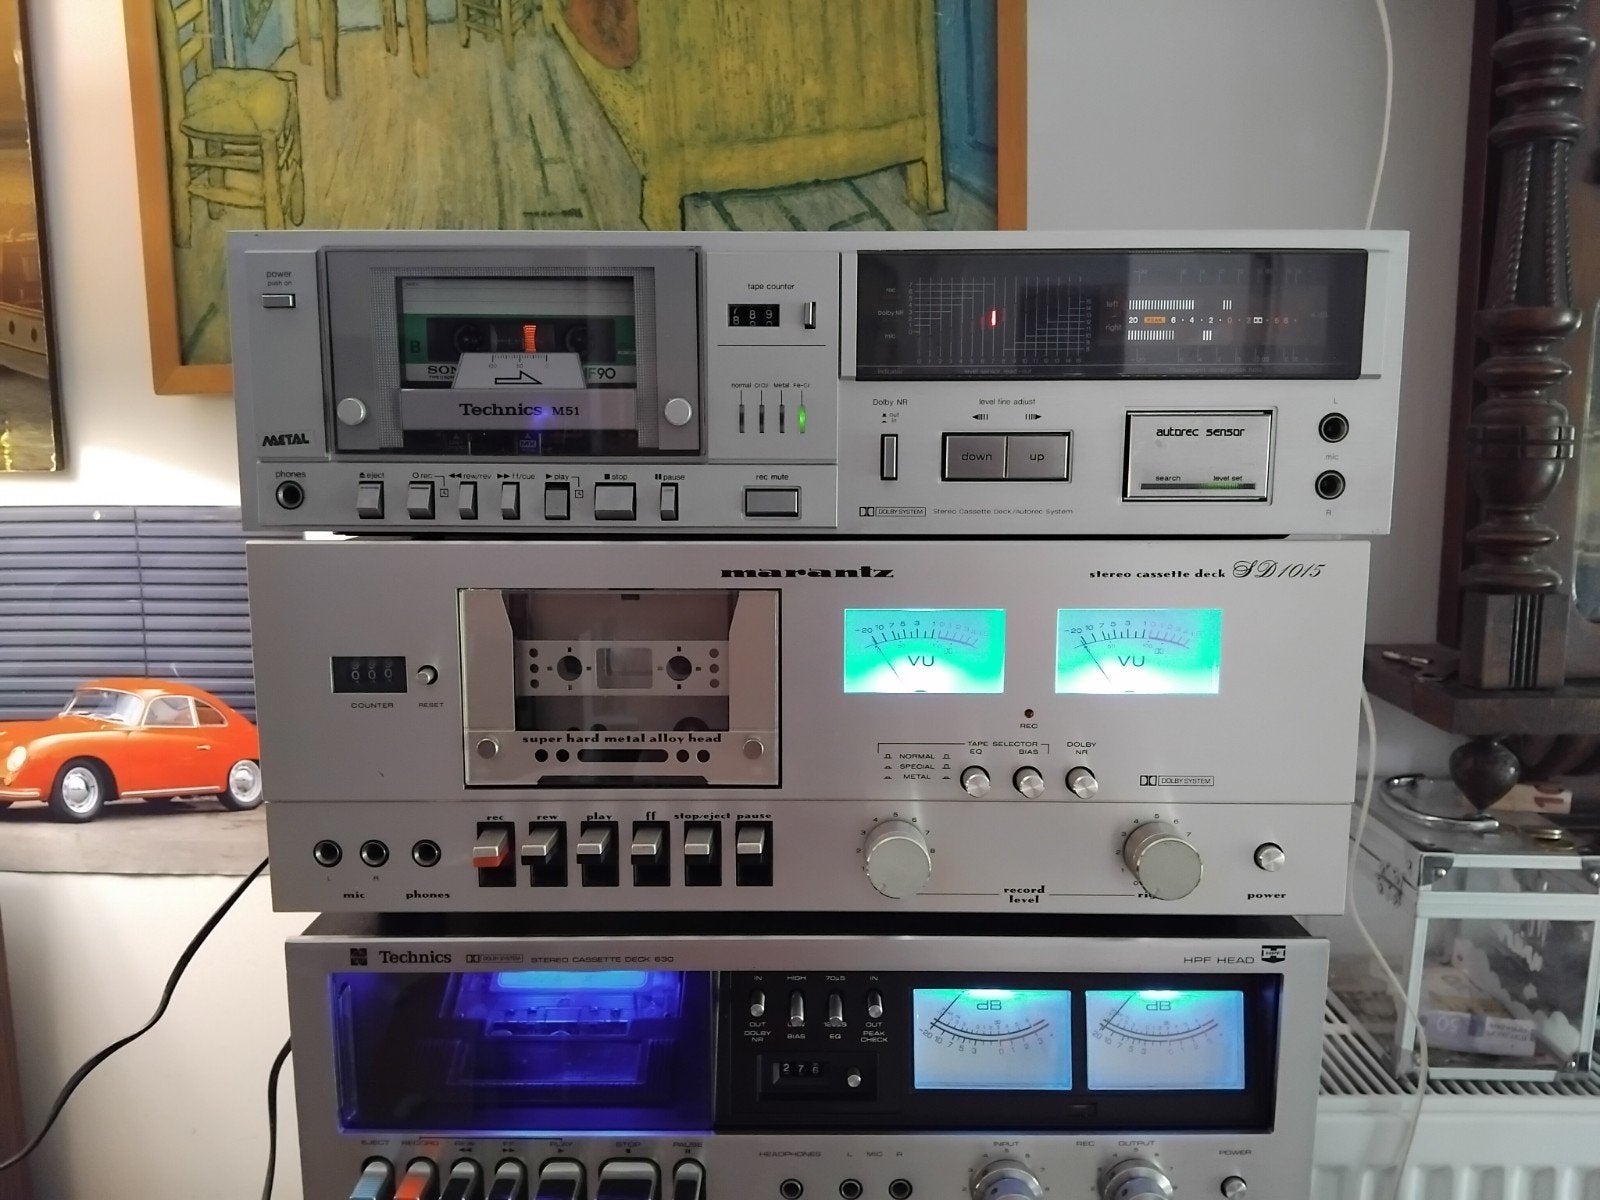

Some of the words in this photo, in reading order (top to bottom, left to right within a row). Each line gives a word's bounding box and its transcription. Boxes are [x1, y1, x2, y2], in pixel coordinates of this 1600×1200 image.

[266, 270, 292, 279] power
[1106, 300, 1119, 308] left
[1128, 316, 1139, 324] 20
[1171, 316, 1176, 324] 6
[1189, 316, 1195, 324] 4
[1208, 316, 1214, 324] 2
[1105, 324, 1122, 333] right
[410, 340, 420, 354] B
[427, 366, 457, 375] SON
[872, 398, 894, 407] Dolby
[896, 398, 908, 406] NR
[979, 398, 996, 406] level
[997, 398, 1011, 406] fine
[1013, 398, 1036, 406] adjust
[459, 403, 543, 416] Technics
[552, 406, 580, 416] M51
[1156, 427, 1199, 437] autorec
[1205, 427, 1245, 437] sensor
[262, 433, 310, 447] METAL
[961, 452, 993, 462] down
[1029, 453, 1044, 463] up
[1325, 453, 1339, 461] mic
[275, 470, 306, 479] phones
[366, 472, 385, 480] eject
[463, 472, 492, 480] rew/rev
[512, 472, 535, 480] ff/cue
[554, 473, 569, 481] play
[612, 473, 628, 481] stop
[1045, 508, 1073, 516] System
[720, 565, 894, 578] marantz
[1089, 569, 1132, 578] stereo
[1136, 569, 1190, 578] cassette
[1194, 569, 1226, 578] deck
[907, 655, 935, 667] VU
[1117, 655, 1145, 667] VU
[522, 735, 562, 745] super
[566, 733, 600, 743] hard
[604, 733, 645, 743] metal
[649, 733, 684, 745] alloy
[688, 733, 722, 743] head
[586, 812, 612, 821] play
[645, 811, 657, 821] ff
[736, 813, 772, 821] pause
[1003, 885, 1046, 894] record
[343, 891, 366, 899] mic
[405, 890, 450, 900] phones
[1009, 895, 1040, 904] level
[1247, 892, 1287, 900] power
[378, 950, 452, 964] Technics
[1183, 956, 1212, 964] HPF
[1216, 956, 1255, 964] HEAD
[976, 999, 1002, 1010] dB
[1145, 1001, 1172, 1011] dB
